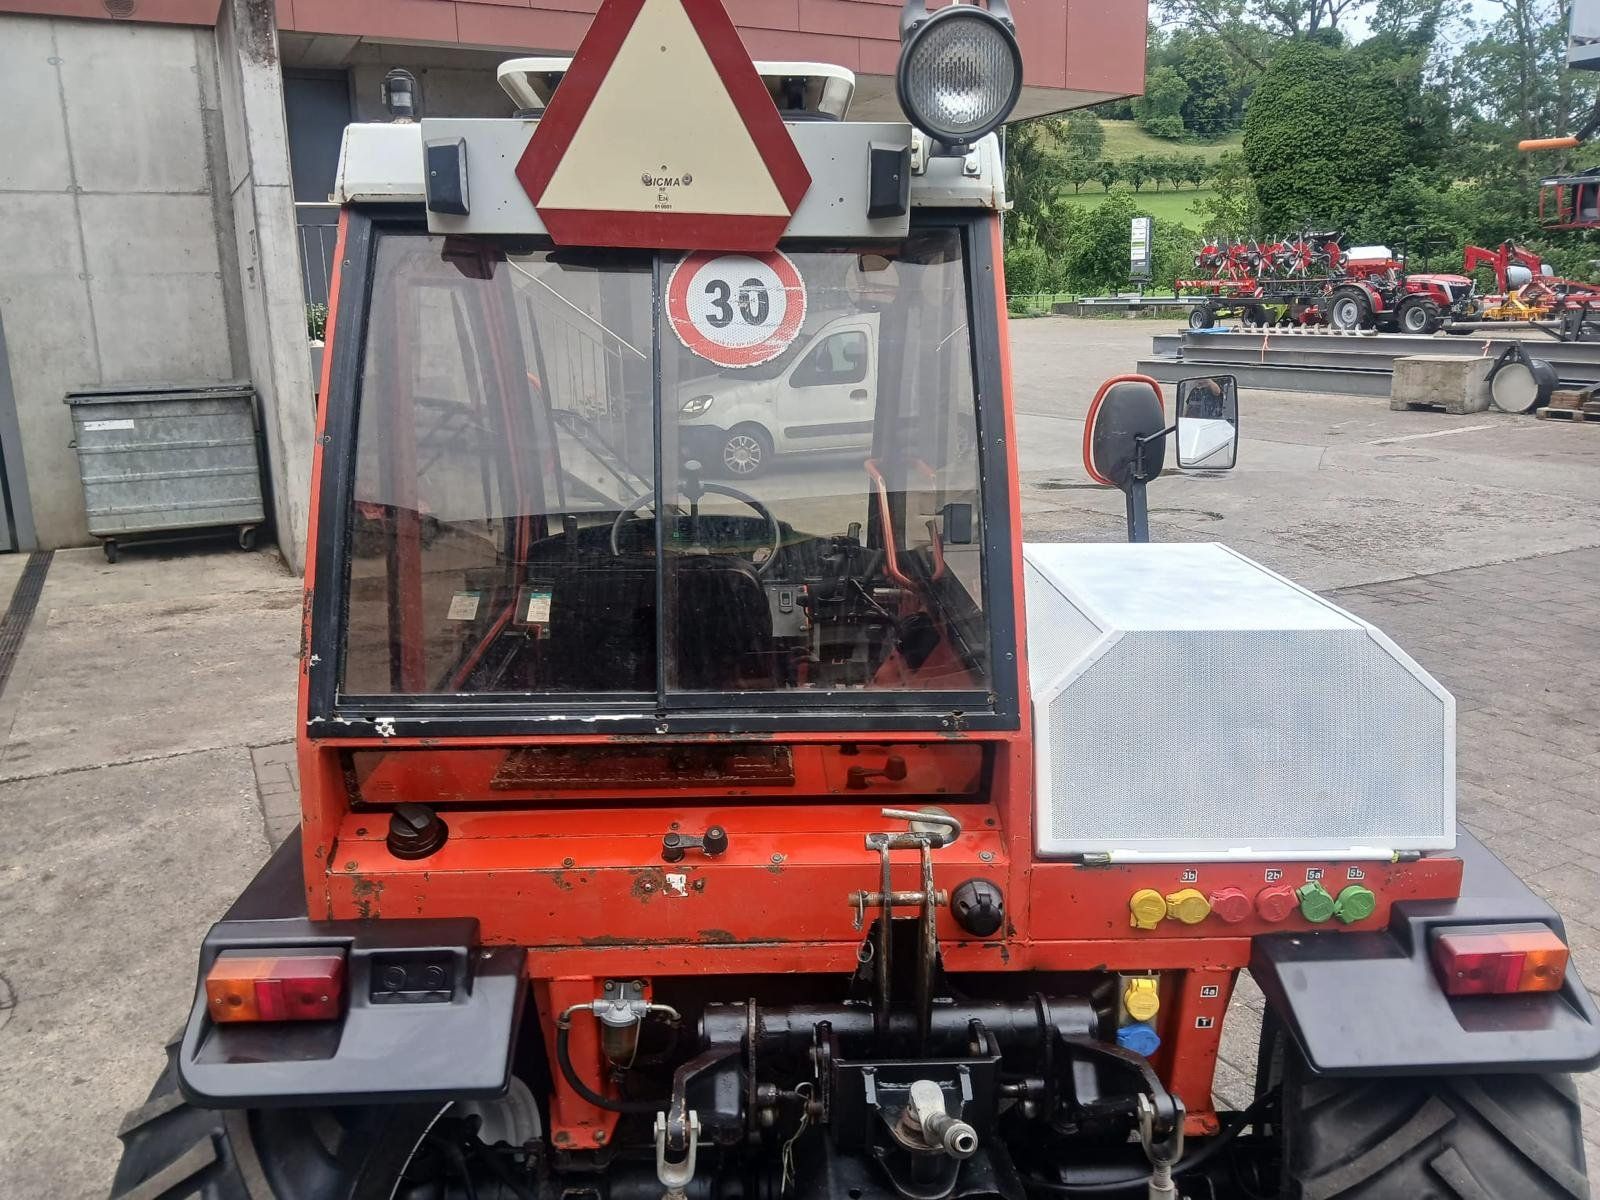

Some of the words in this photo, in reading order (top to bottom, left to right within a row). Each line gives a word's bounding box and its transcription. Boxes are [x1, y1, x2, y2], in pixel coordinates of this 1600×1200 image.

[704, 277, 770, 329] 30
[1182, 871, 1195, 880] 3b
[1267, 871, 1280, 880] 2b
[1309, 870, 1321, 879] 5a
[1349, 868, 1362, 877] 5b
[1203, 987, 1215, 995] 4a
